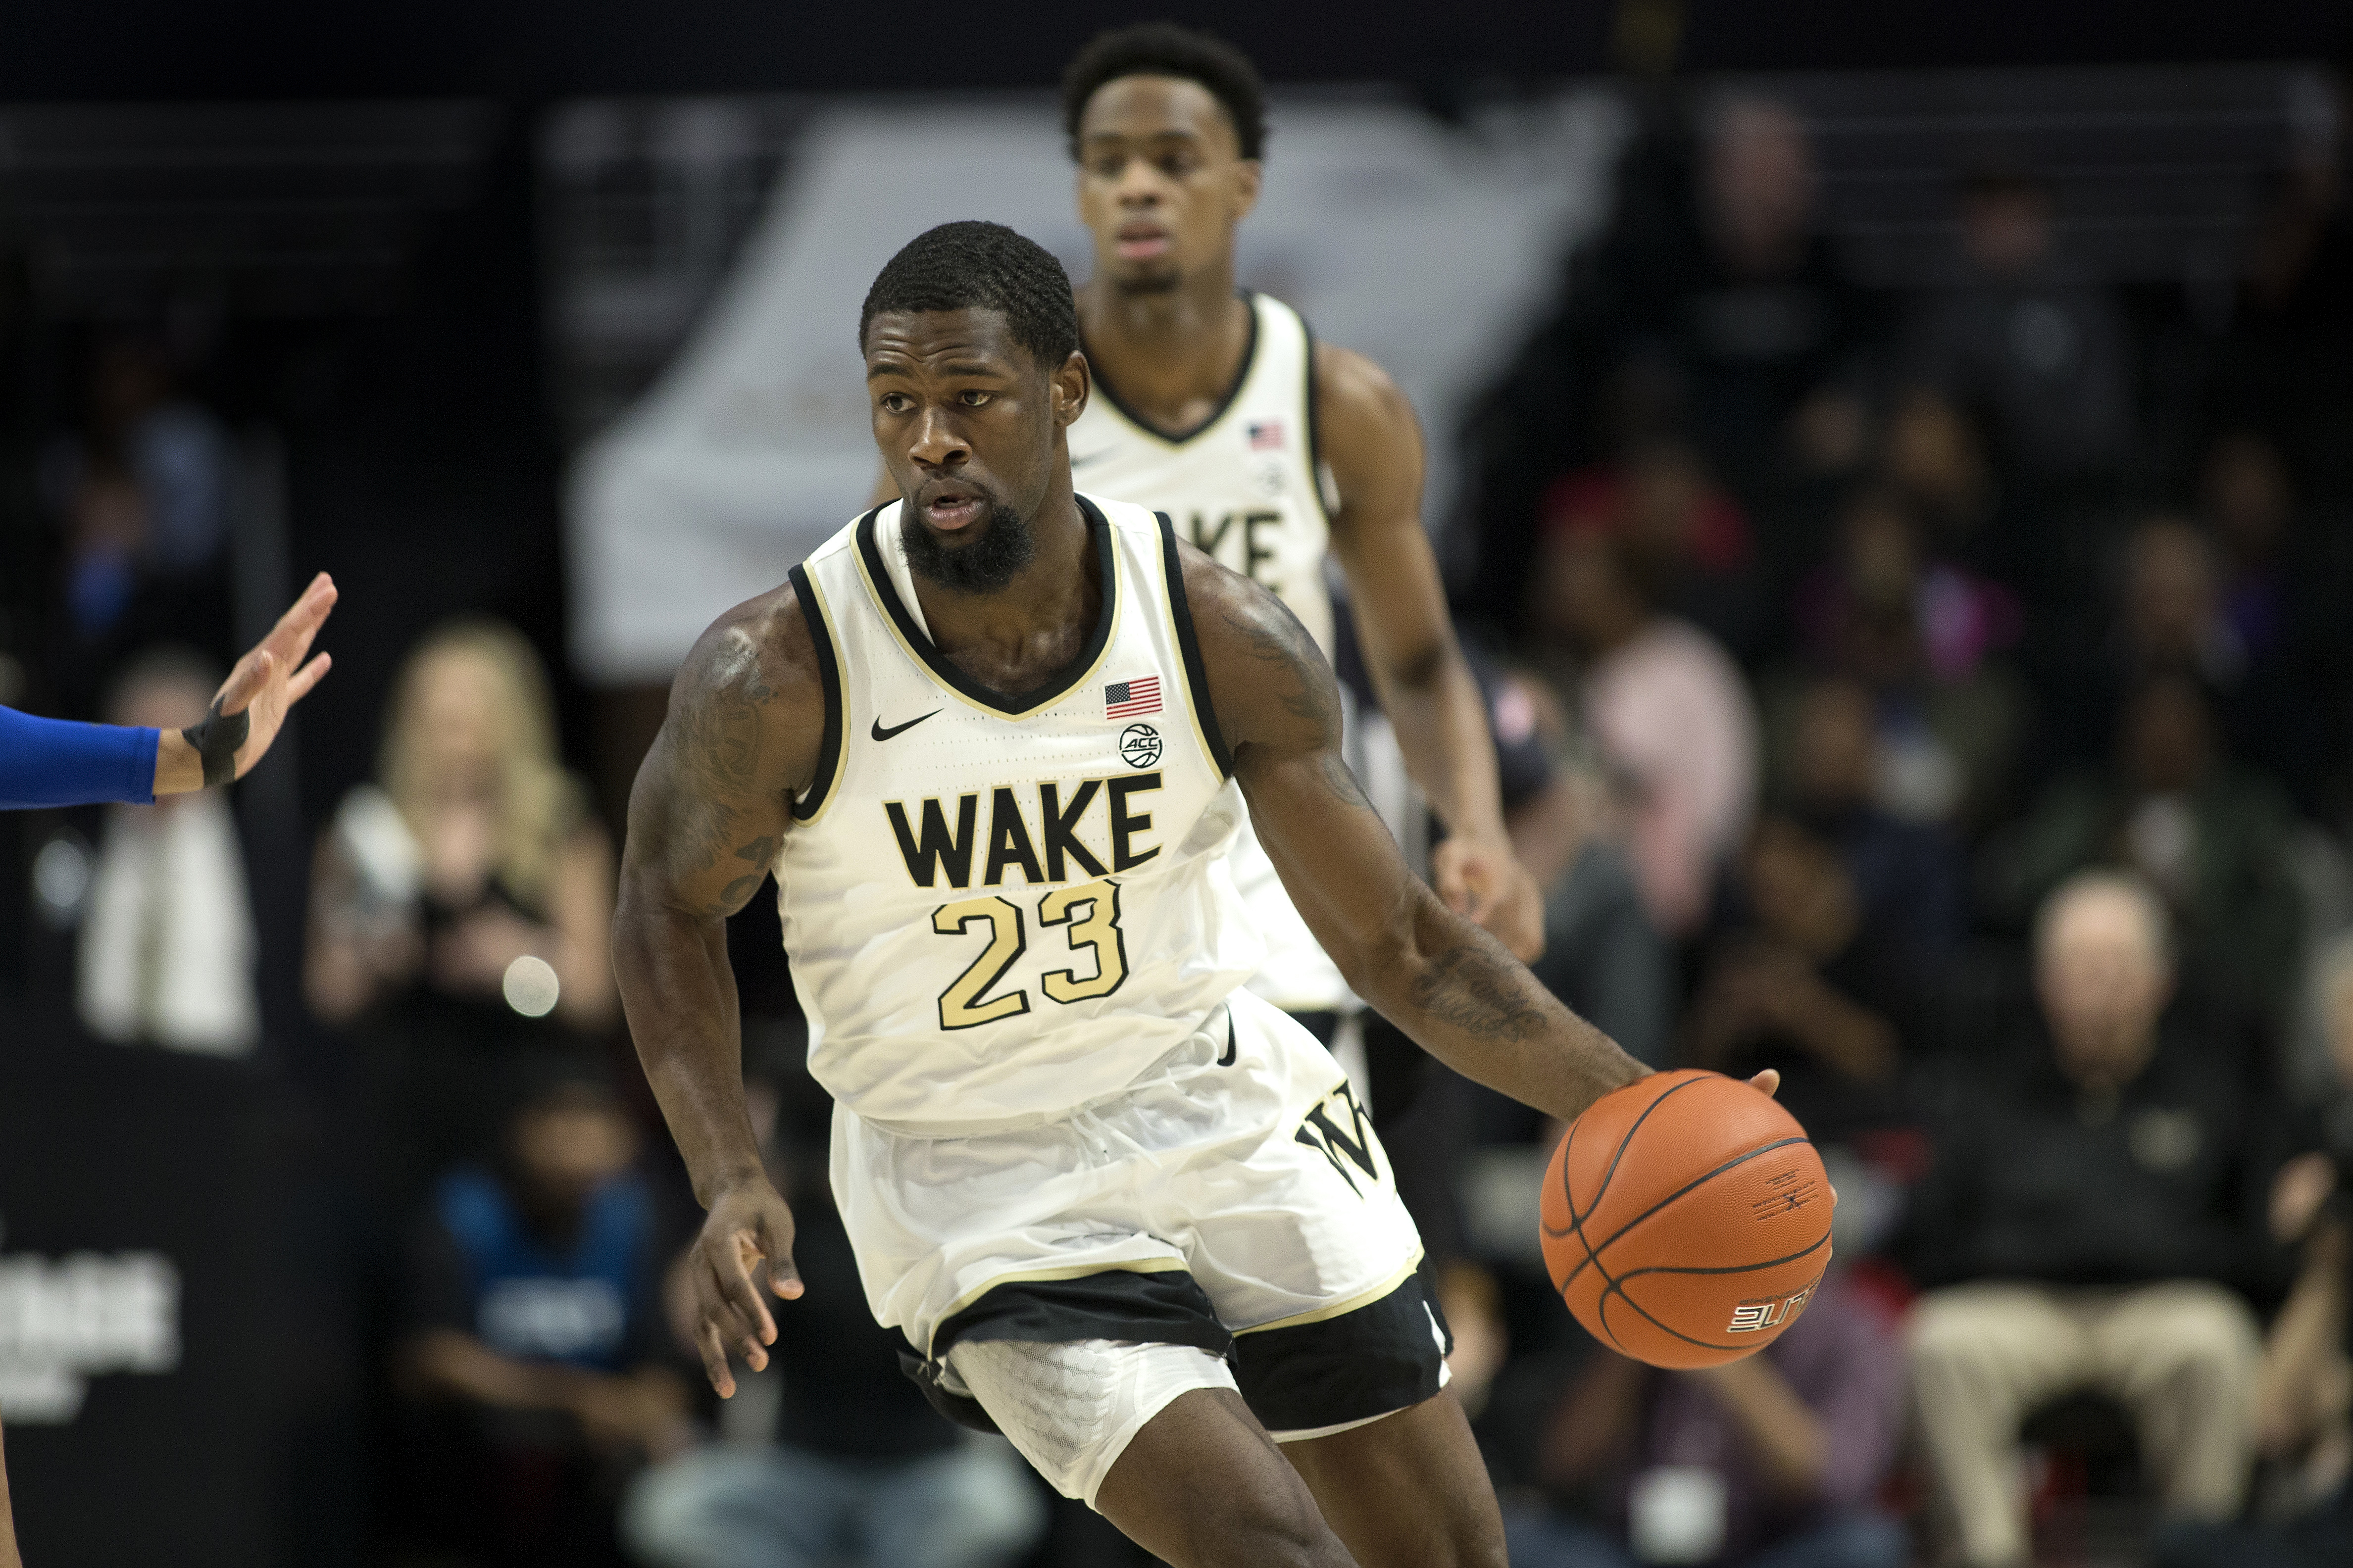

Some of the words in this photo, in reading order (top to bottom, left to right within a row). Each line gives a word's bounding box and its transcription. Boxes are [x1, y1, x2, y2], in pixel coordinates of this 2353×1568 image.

[1191, 508, 1284, 593] KE
[1124, 736, 1159, 749] ACC
[882, 769, 1164, 889] WAKE
[931, 878, 1129, 1030] 23
